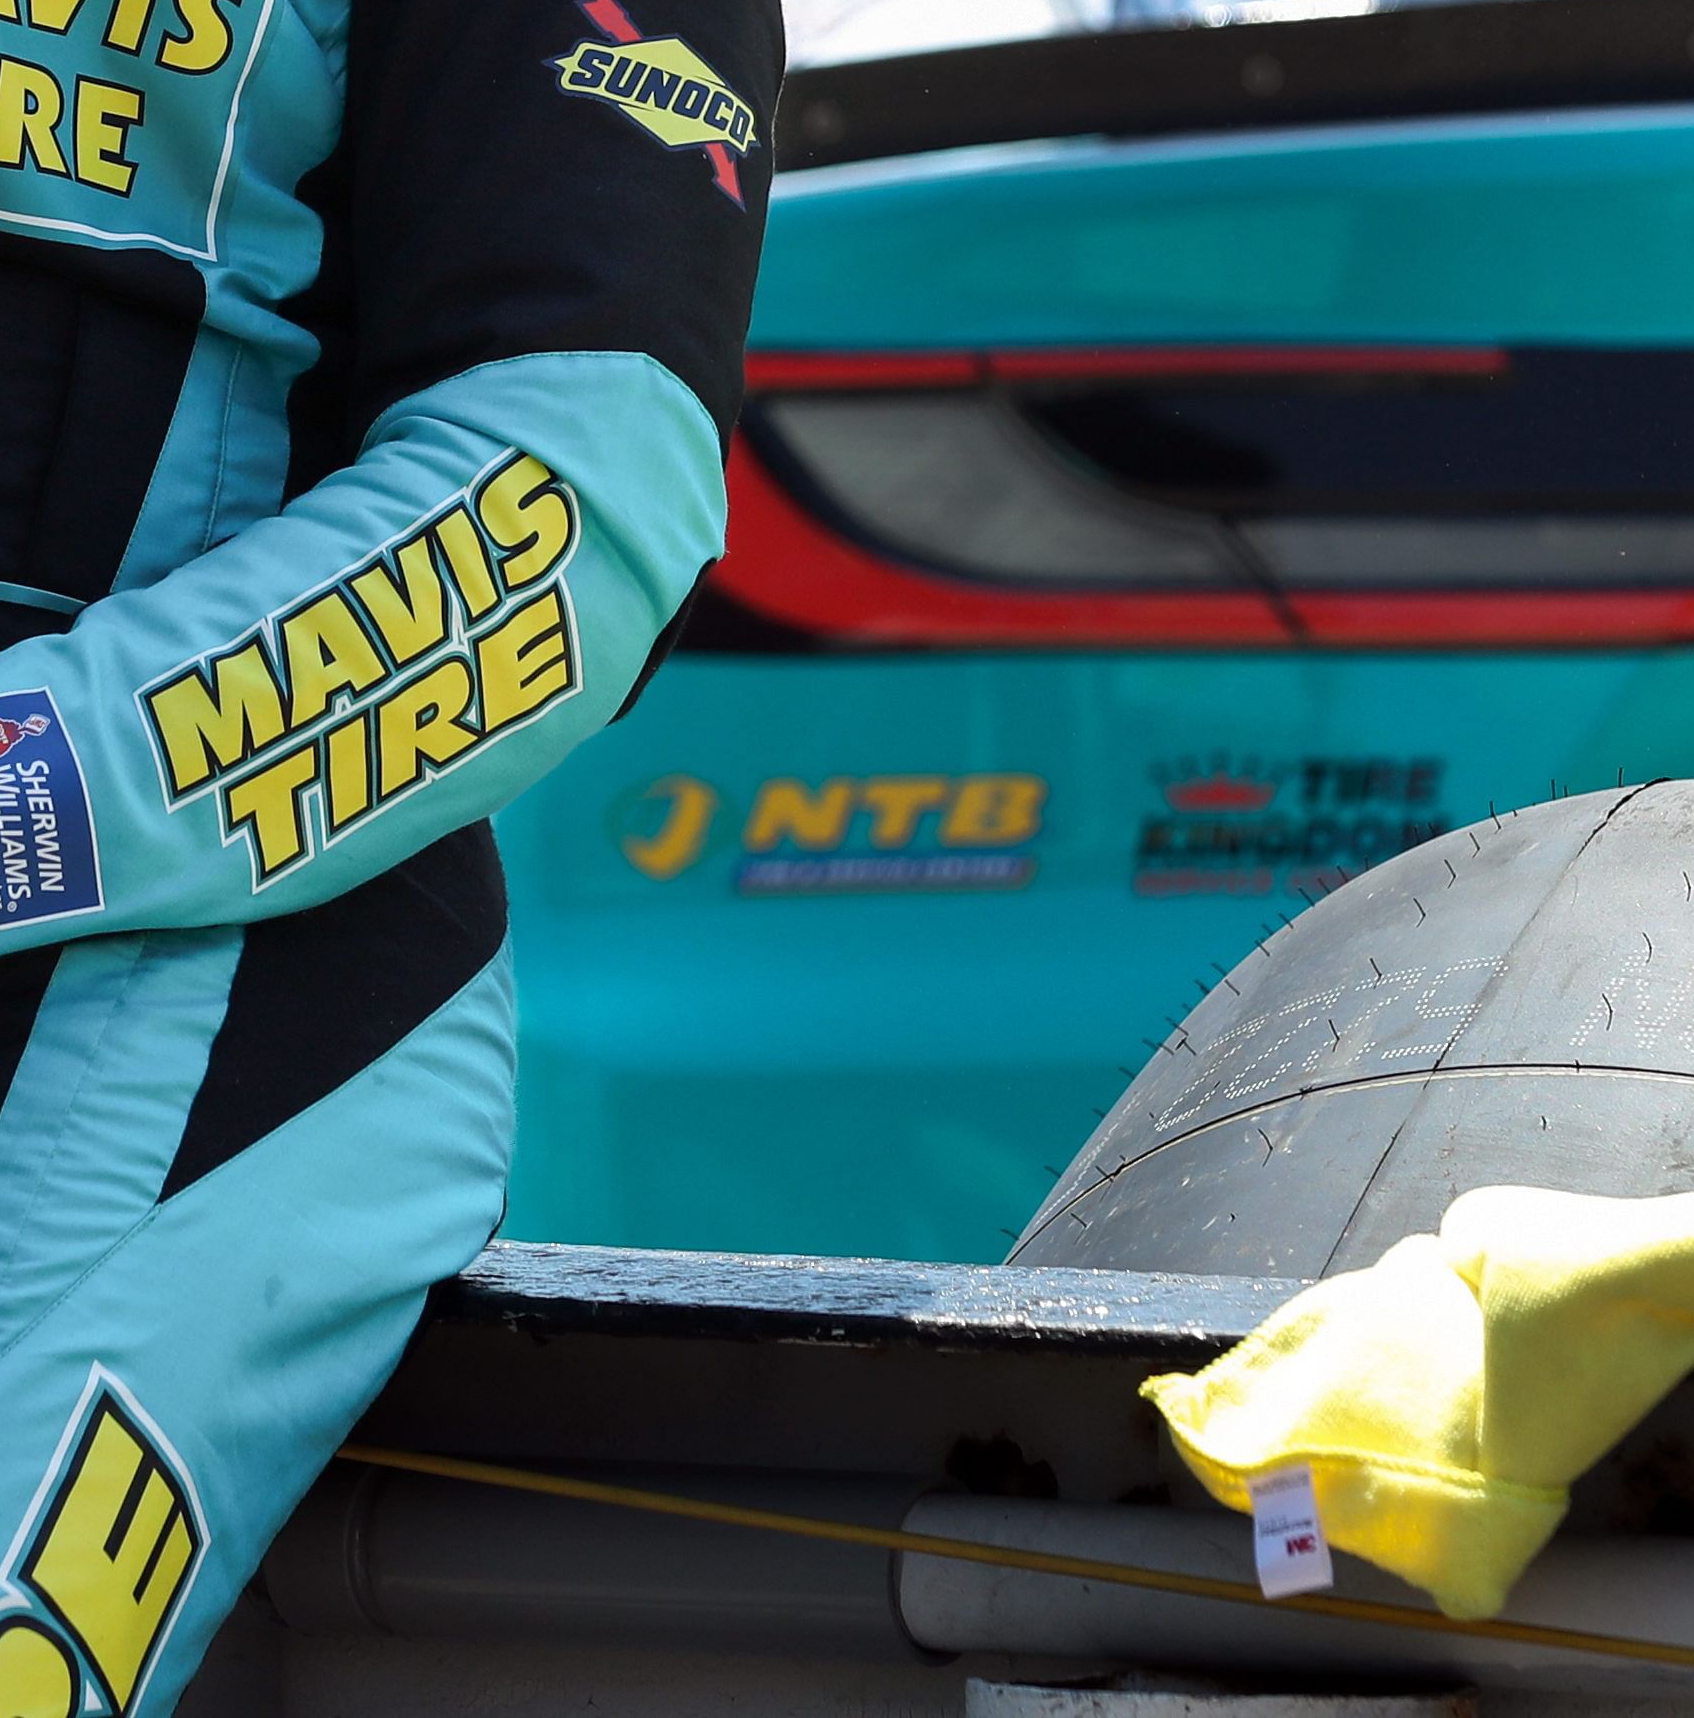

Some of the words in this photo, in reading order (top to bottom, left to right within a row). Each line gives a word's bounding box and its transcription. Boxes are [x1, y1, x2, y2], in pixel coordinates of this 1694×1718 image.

[569, 46, 753, 143] SUNOCO
[144, 449, 576, 802] MAVIS
[223, 580, 575, 881] TIRE
[15, 759, 65, 893] SHERWIN
[742, 773, 1048, 852] NTB
[1299, 754, 1447, 808] TIRE
[1285, 1532, 1317, 1557] 3M
